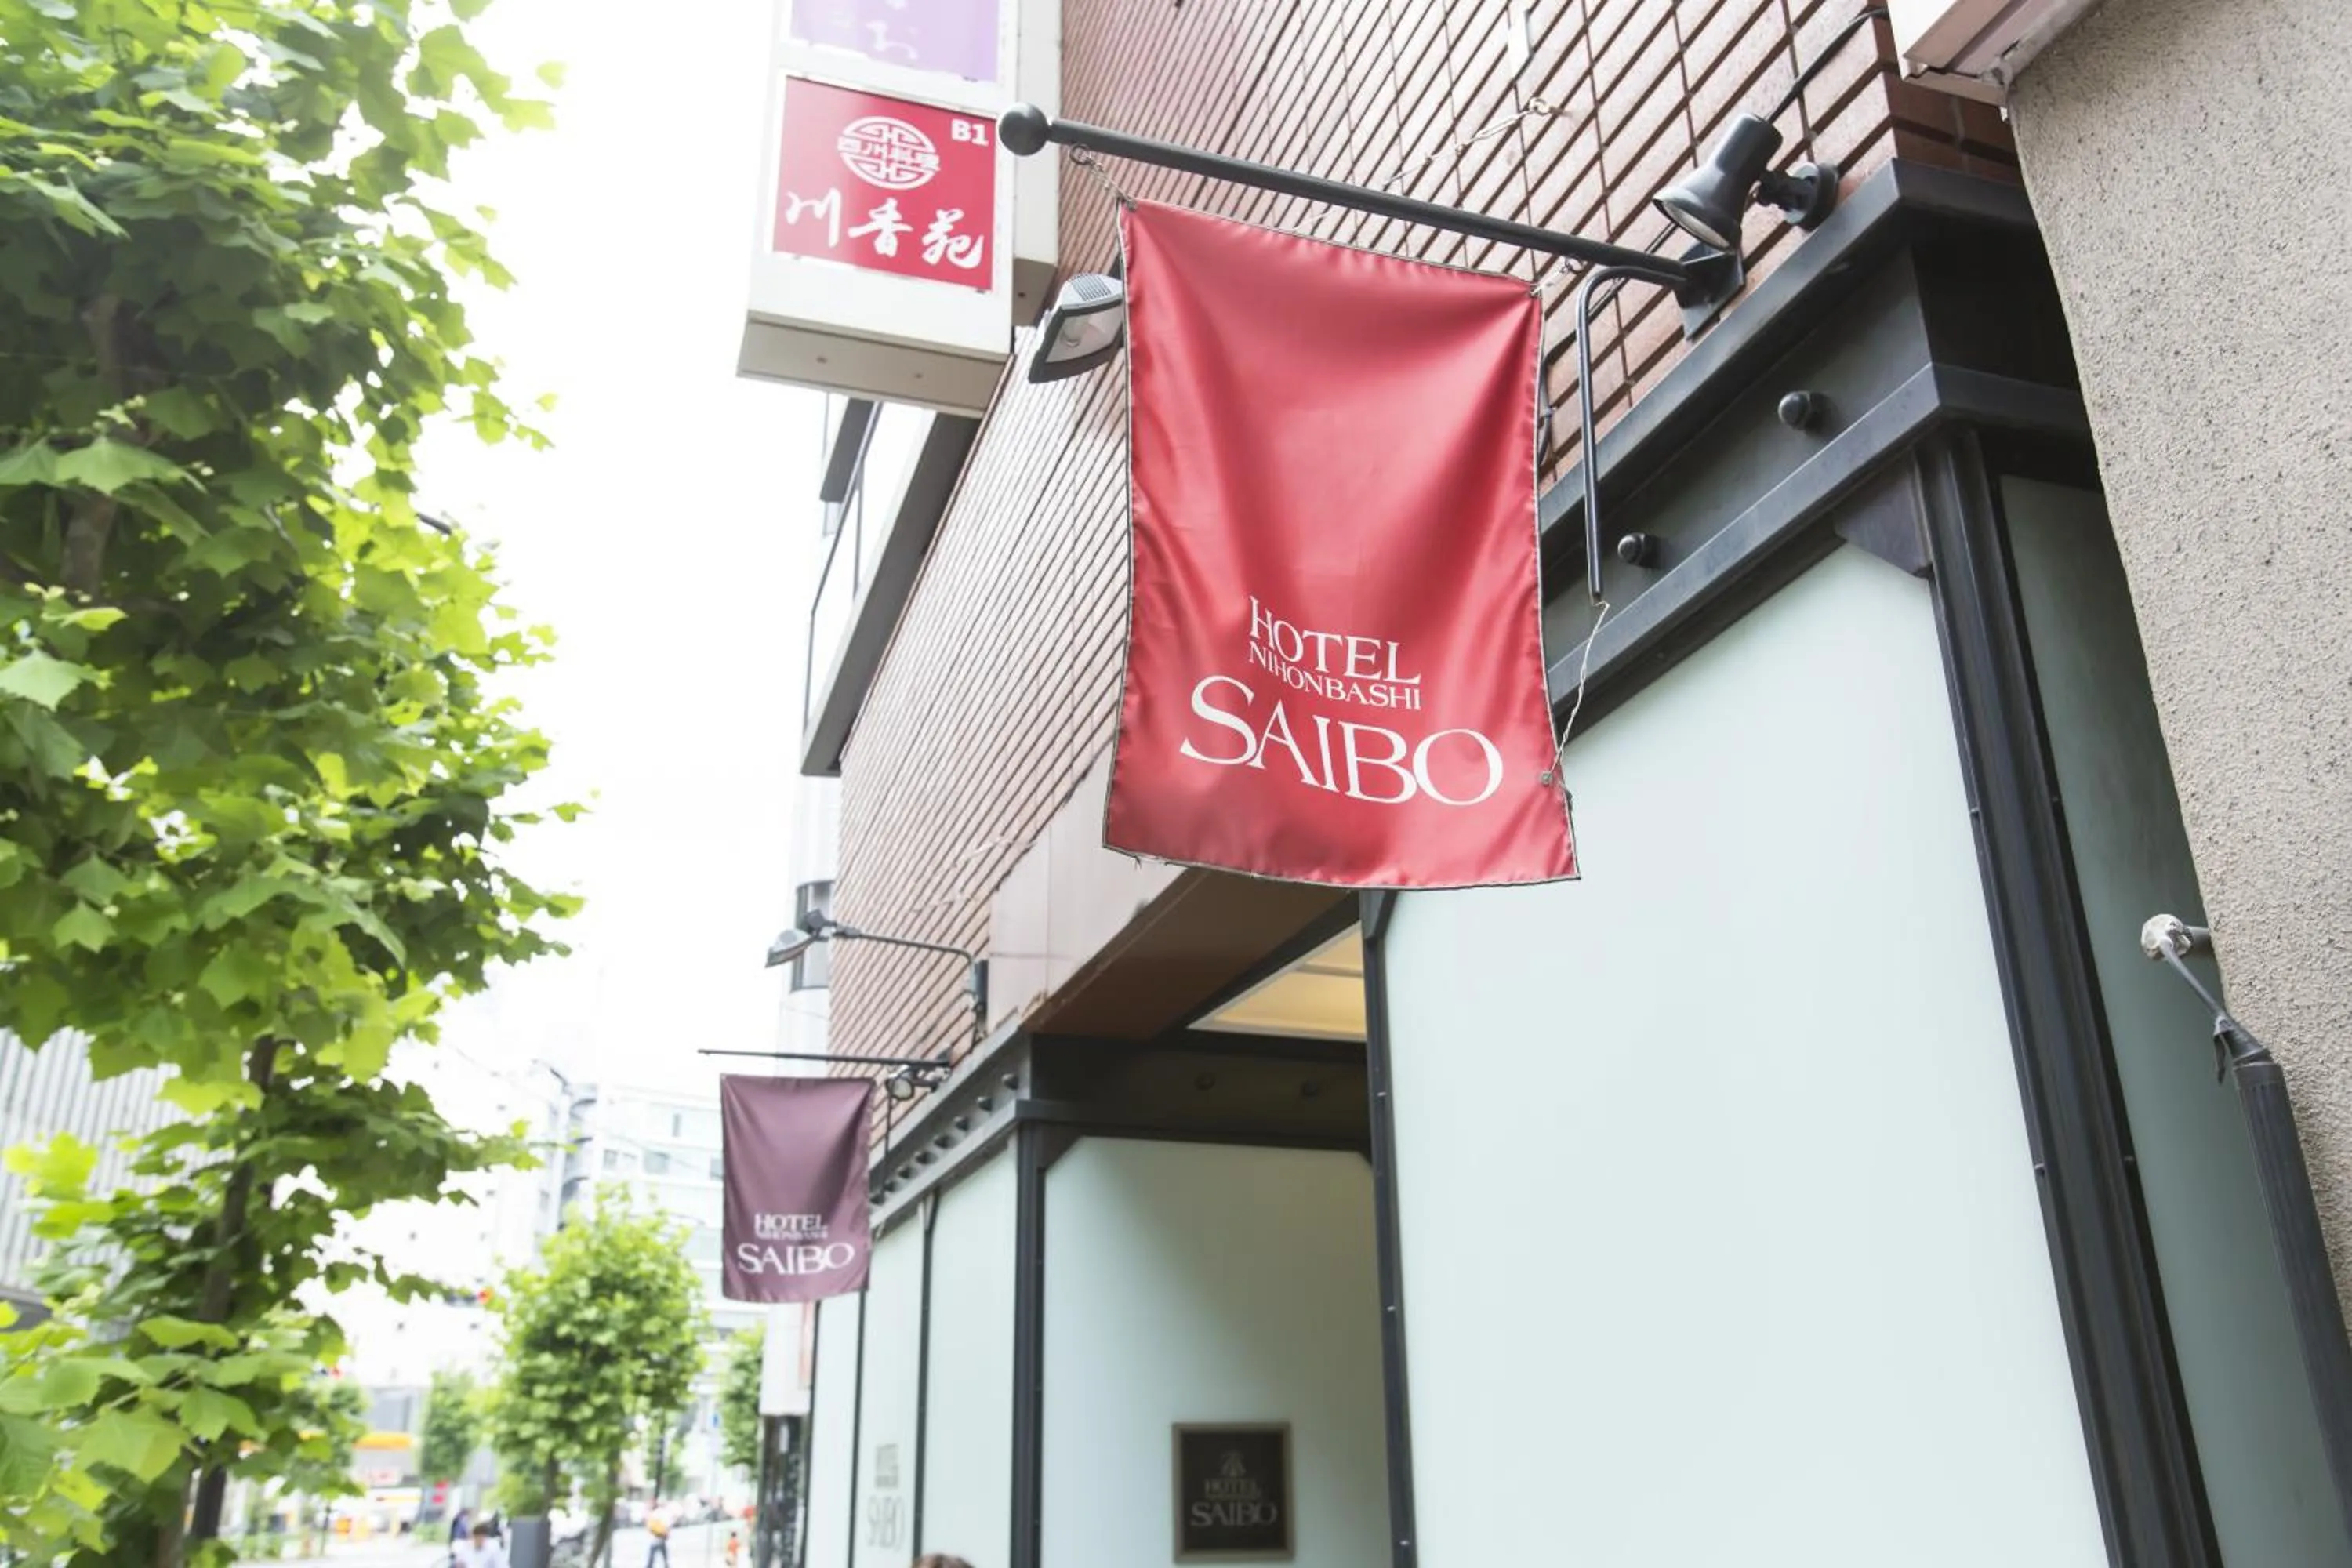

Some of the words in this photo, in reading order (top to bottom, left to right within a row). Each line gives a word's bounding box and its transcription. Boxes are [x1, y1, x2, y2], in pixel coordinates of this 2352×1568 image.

[951, 119, 989, 146] B1
[786, 187, 985, 270] 川香苑
[1249, 595, 1421, 684] HOTEL
[1249, 641, 1421, 710] NIHONBASHI
[1180, 675, 1503, 806] SAIBO
[754, 1213, 828, 1231] HOTEL
[737, 1242, 855, 1275] SAIBO
[1190, 1501, 1278, 1526] SAIBO
